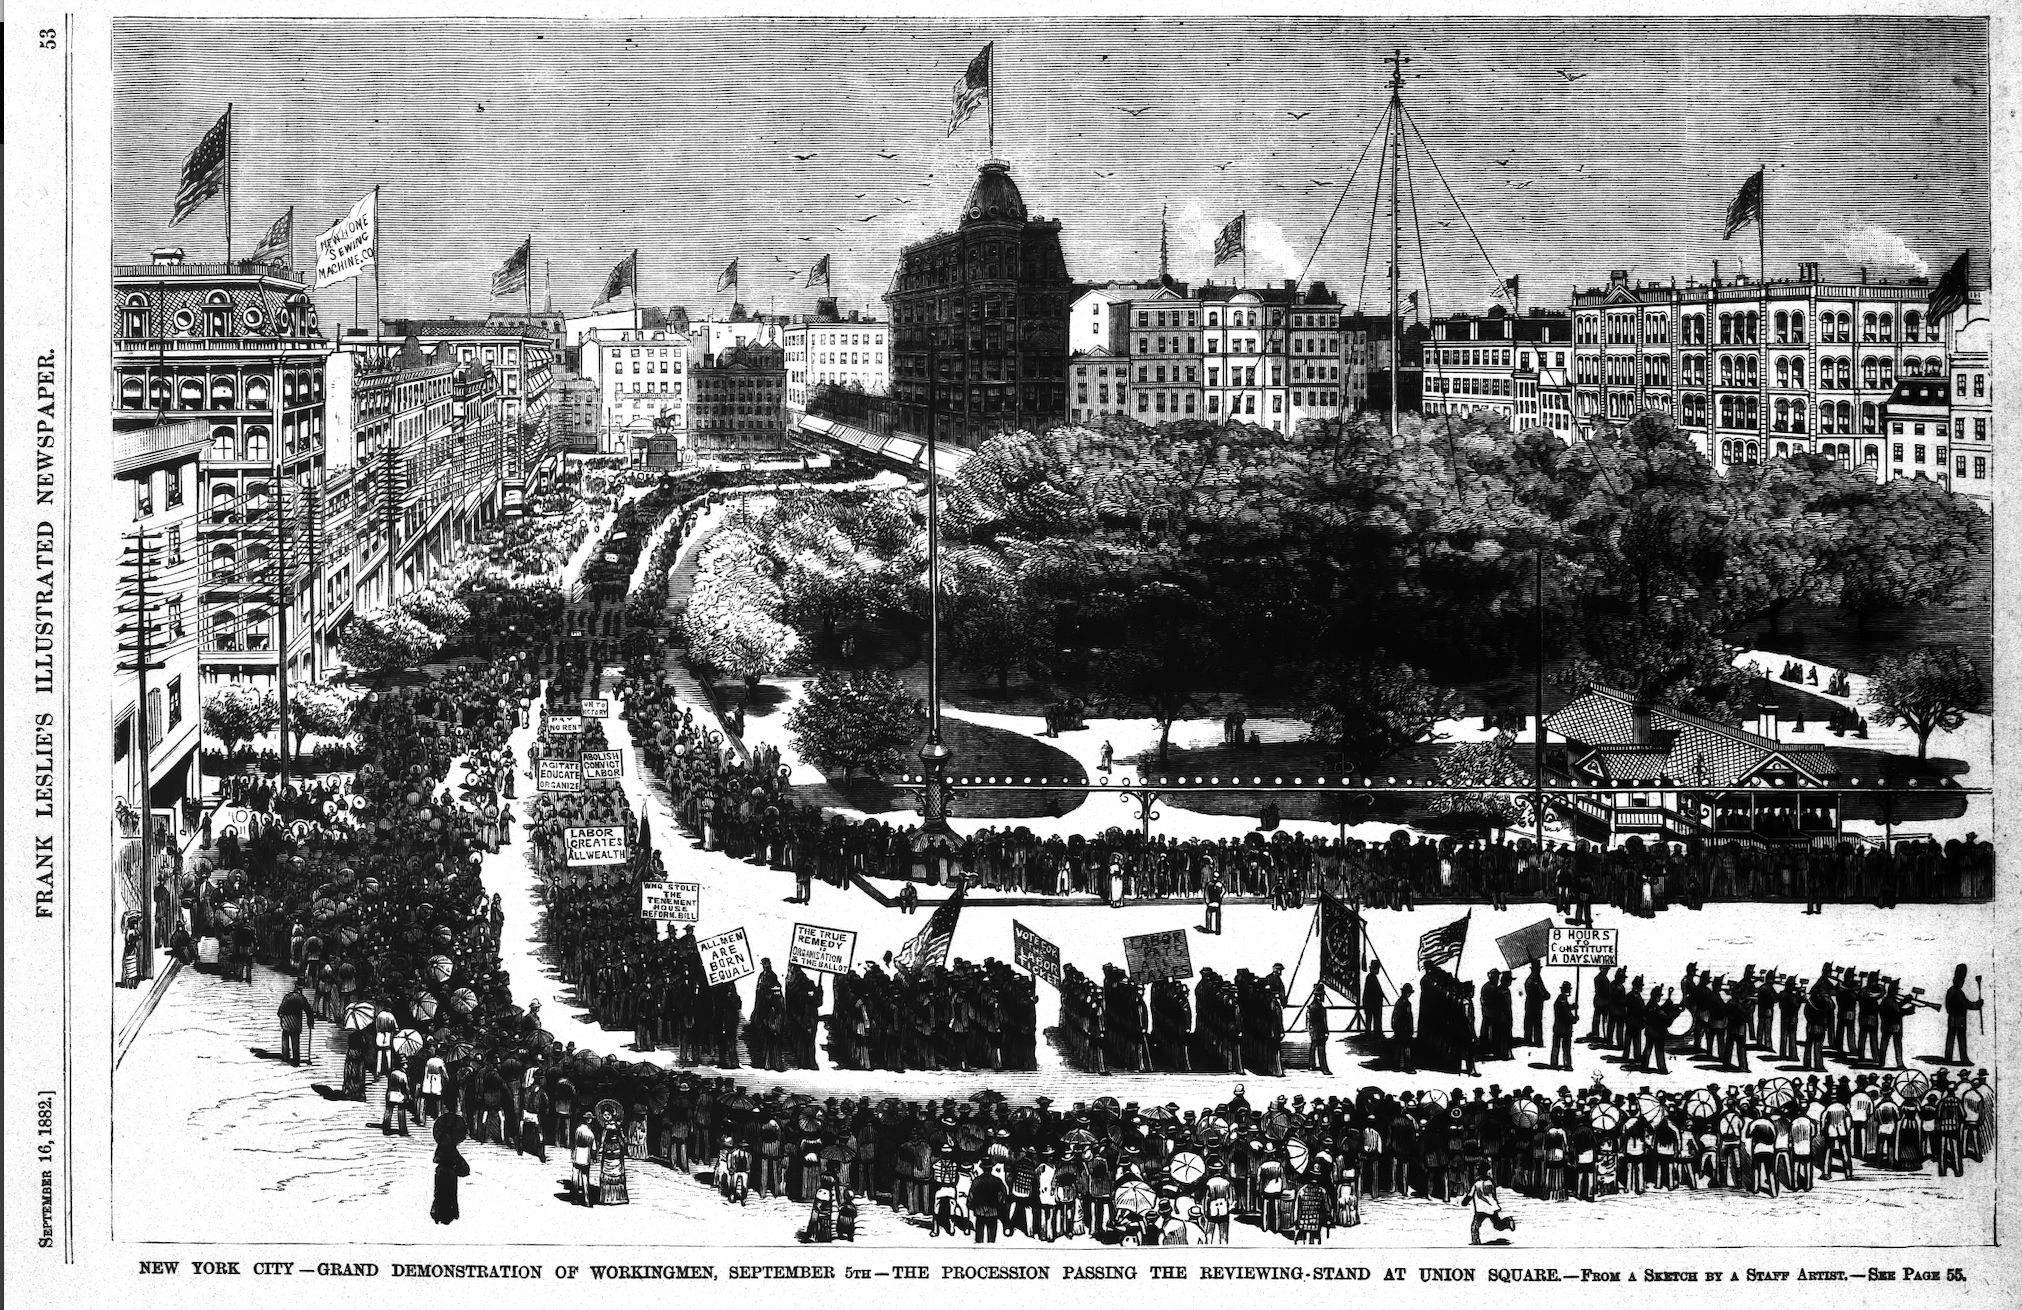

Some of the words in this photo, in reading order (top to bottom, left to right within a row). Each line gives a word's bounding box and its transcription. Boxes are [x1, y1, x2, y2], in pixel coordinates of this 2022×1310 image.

[40, 28, 56, 50] 53
[320, 233, 341, 252] NEW
[329, 231, 369, 260] SEWING
[37, 349, 54, 505] NEWSPAPER.
[35, 522, 54, 693] ILLUSTRATED
[583, 752, 619, 761] ABOLISH
[36, 714, 54, 818] LESLIE'S
[541, 761, 580, 770] AGITATE
[583, 761, 620, 770] CONVICT
[587, 769, 620, 778] LABOR
[540, 770, 580, 779] EDUCATE
[540, 780, 580, 790] ORGANIZE
[570, 828, 614, 838] LABOR
[570, 838, 623, 848] CREATES
[568, 847, 586, 860] ALL
[585, 849, 625, 860] WEALTH
[36, 836, 54, 918] FRANK
[663, 891, 682, 899] THE
[668, 884, 697, 892] STOLE
[647, 896, 697, 906] TENEMENT
[653, 904, 688, 912] HOUSE
[700, 940, 721, 952] ALL
[720, 931, 743, 945] MEN
[798, 926, 817, 937] THE
[820, 930, 847, 942] TRUE
[798, 935, 843, 950] REMEDY
[1015, 927, 1040, 945] VOTE
[1040, 941, 1058, 958] FOR
[1131, 931, 1184, 950] LABOR
[1553, 929, 1561, 941] 8
[1568, 929, 1610, 940] HOURS
[712, 944, 737, 960] ARE
[792, 946, 843, 964] ORGANISATION
[1551, 953, 1558, 963] A
[709, 953, 745, 972] BORN
[791, 955, 798, 963] &
[801, 957, 817, 967] THE
[818, 961, 848, 973] BALLOT
[1018, 954, 1060, 985] TICKET
[1020, 946, 1058, 976] LABOR
[709, 965, 750, 984] EQUAL
[38, 1171, 54, 1247] SEPTEMBER
[139, 1261, 179, 1275] NEW
[192, 1261, 240, 1275] YORK
[392, 1263, 542, 1279] DEMONSTRATION
[556, 1265, 579, 1279] OF
[590, 1265, 718, 1281] WORKINGMEN,
[730, 1265, 836, 1280] SEPTEMBER
[942, 1266, 1050, 1280] PROCESSION
[1063, 1266, 1138, 1280] PASSING
[1150, 1266, 1187, 1280] THE
[1383, 1267, 1407, 1281] AT
[1418, 1267, 1475, 1283] UNION
[1946, 1267, 1967, 1282] 55.
